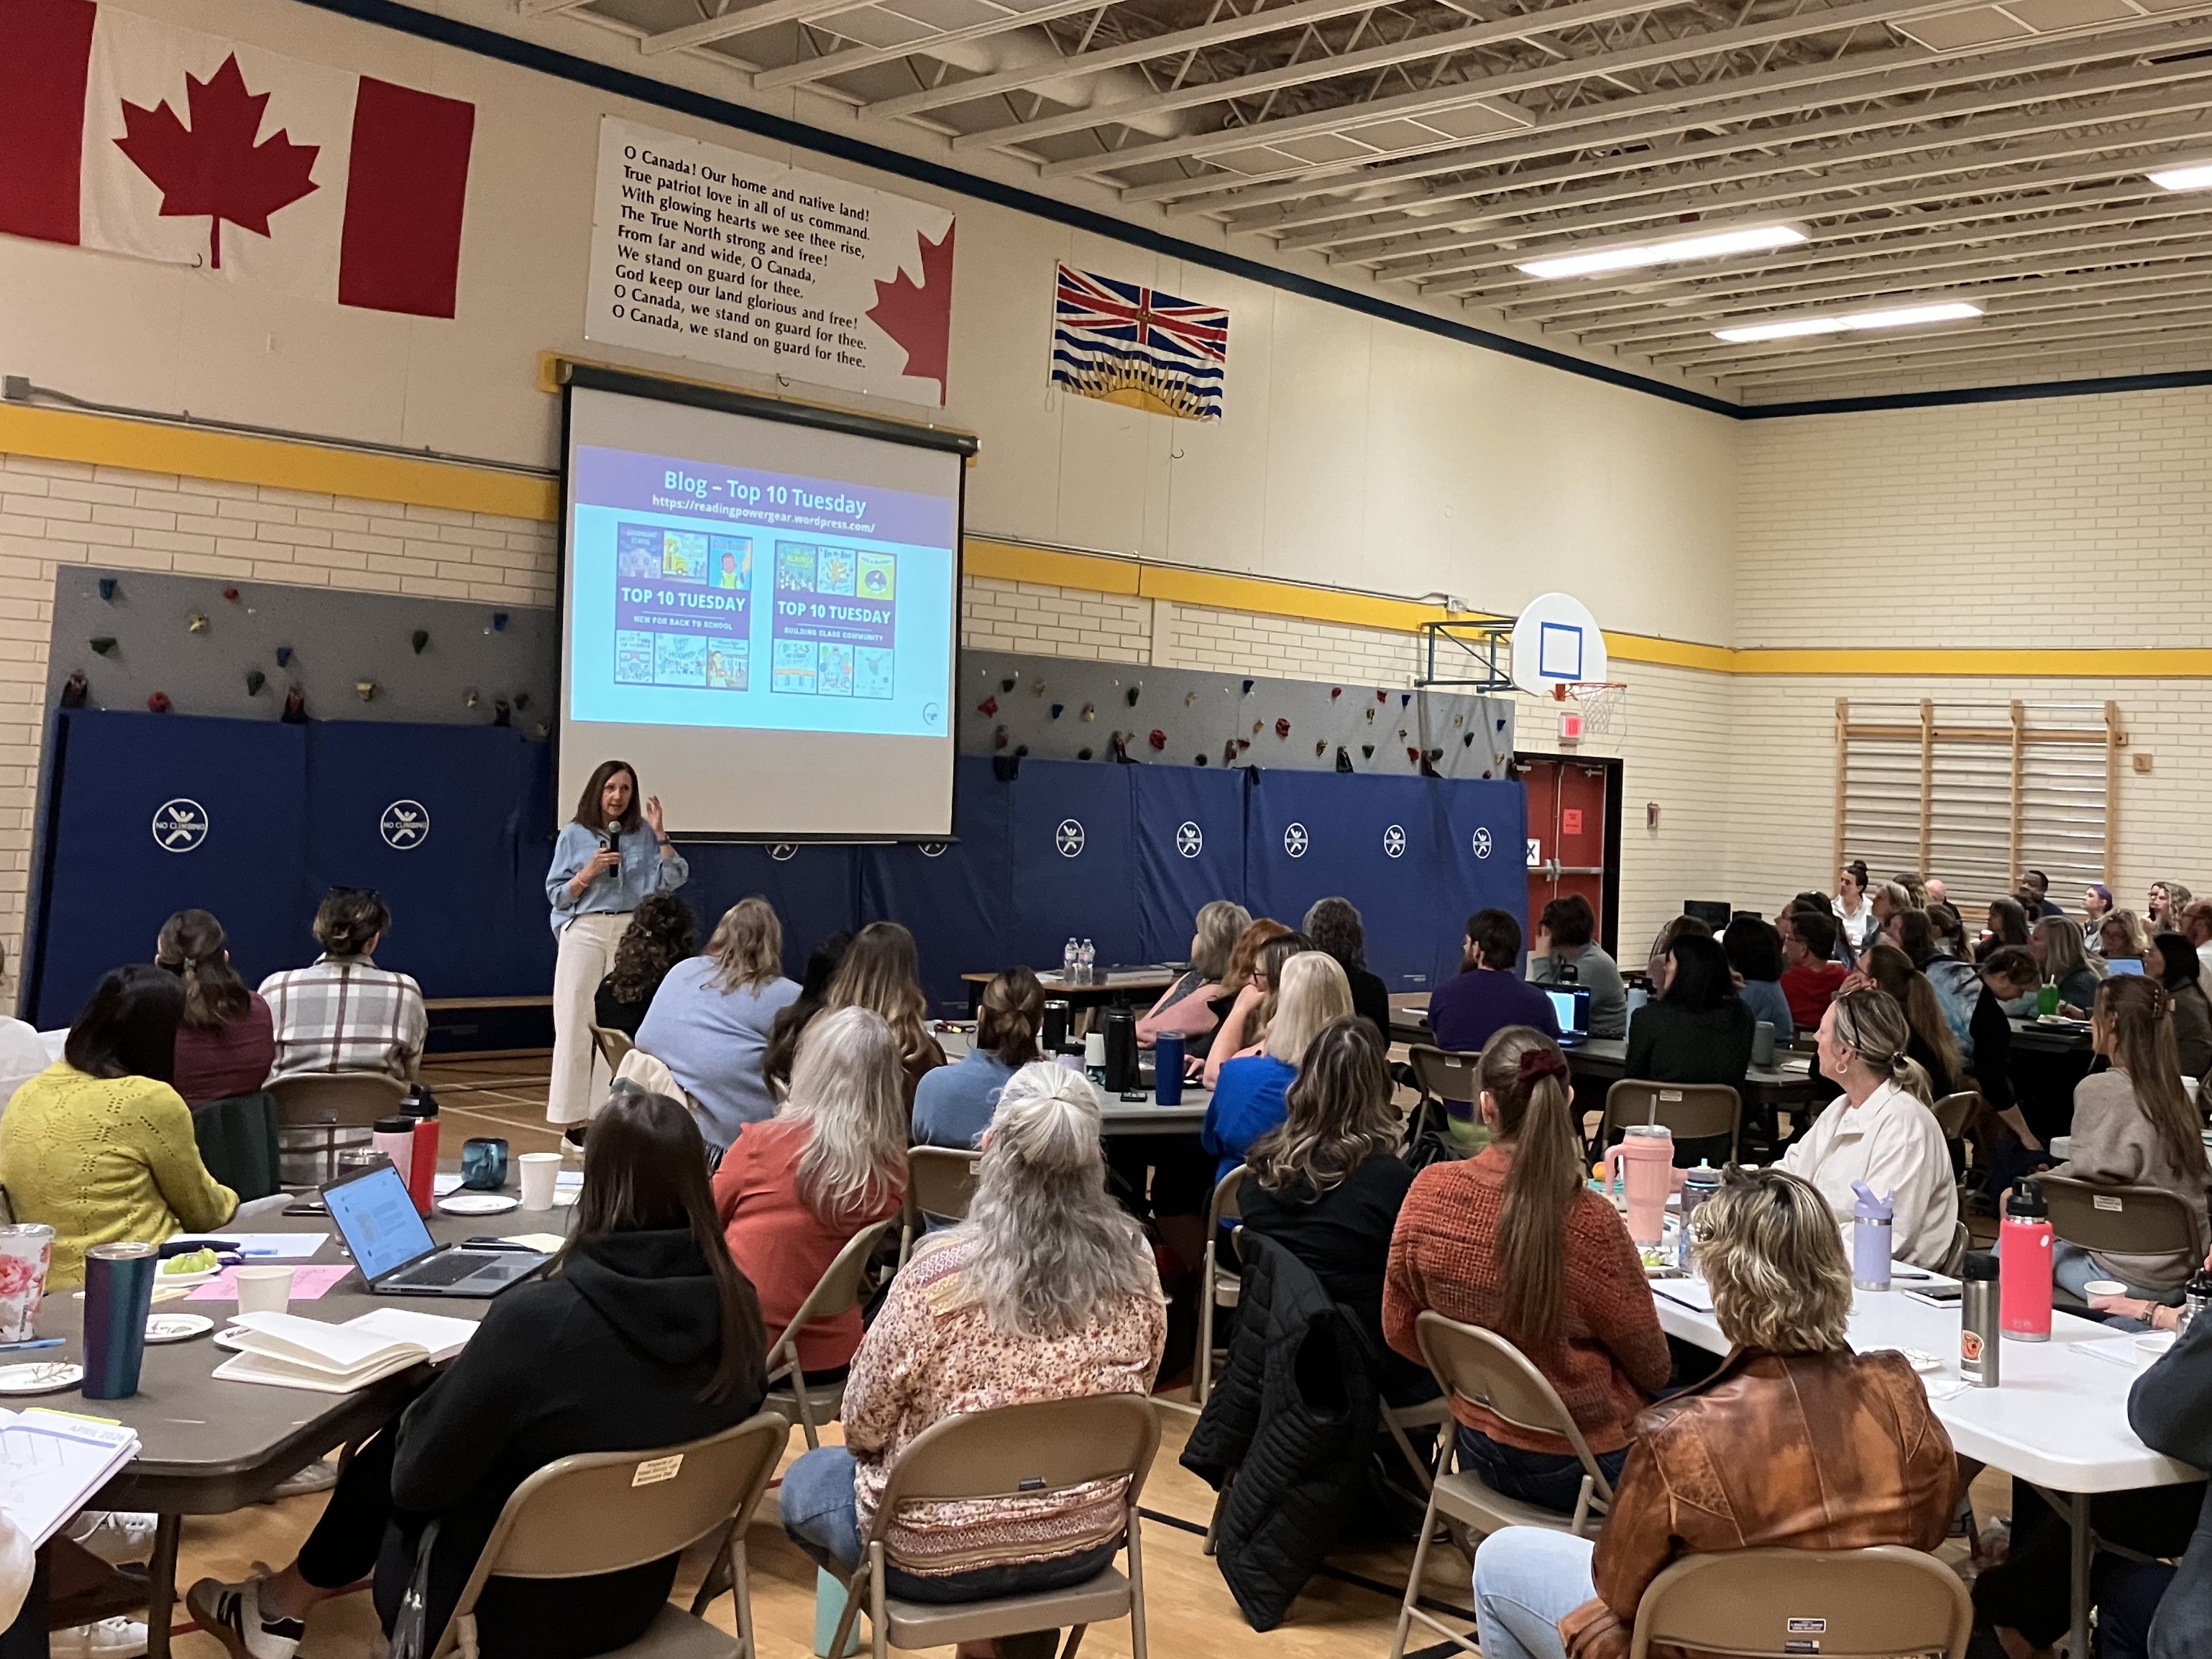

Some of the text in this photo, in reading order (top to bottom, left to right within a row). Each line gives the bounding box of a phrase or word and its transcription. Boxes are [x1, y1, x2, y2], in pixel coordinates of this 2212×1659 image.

[623, 145, 869, 223] O Canada! Our home and native land!
[623, 164, 870, 241] True patriot love in all of us command.
[620, 203, 828, 267] The True North strong and free!
[621, 184, 865, 259] With glowing hearts we see thee rise,
[617, 244, 804, 299] We stand on guard for thee.
[618, 224, 816, 285] From far and wide, O Canada,
[613, 283, 867, 350] O Canada, we stand on guard for thee.
[615, 264, 858, 330] God keep our land glorious and free!
[612, 303, 866, 369] O Canada, we stand on guard for thee.
[652, 495, 876, 533] https://readingpowergear.wordpress.com/
[664, 470, 707, 499] Blog
[726, 479, 761, 505] Top
[766, 484, 788, 505] 10
[791, 488, 867, 520] Tuesday
[620, 587, 746, 612] TOP 10 TUESDAY
[652, 617, 668, 625] FOR
[669, 617, 690, 627] BACK
[703, 621, 733, 630] SCHOOL
[777, 600, 891, 625] TOP 10 TUESDAY
[784, 627, 884, 642] BUILDING CLASS COMMUNITY
